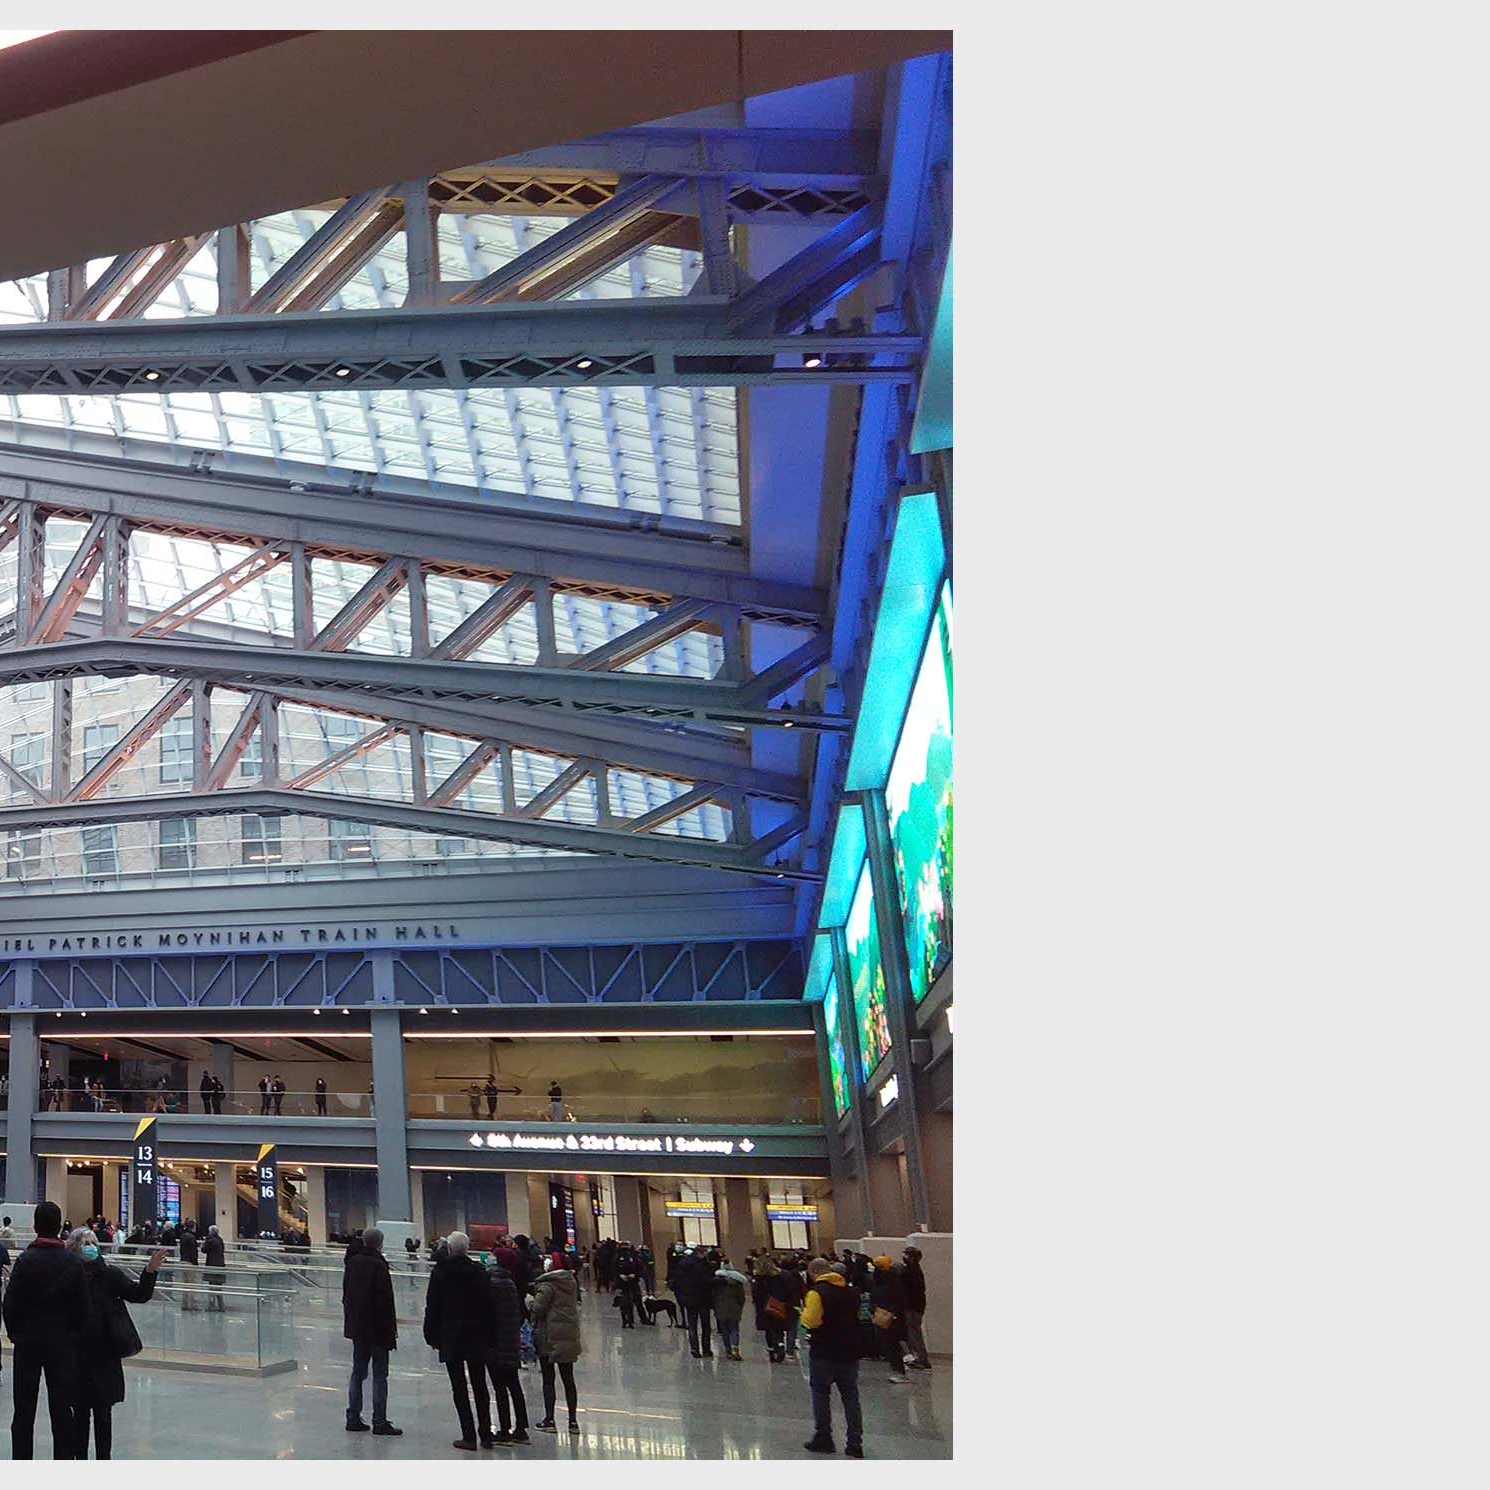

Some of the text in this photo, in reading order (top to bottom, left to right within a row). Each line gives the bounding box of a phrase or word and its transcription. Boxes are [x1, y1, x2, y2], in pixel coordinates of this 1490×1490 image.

[48, 935, 143, 950] PATRICK
[159, 931, 285, 947] MOYNIHAN
[300, 927, 377, 943] TRAIN
[395, 925, 459, 940] HALL
[615, 1135, 662, 1152] Street
[675, 1136, 734, 1155] Subway
[138, 1146, 153, 1160] 13
[137, 1169, 153, 1185] 14
[261, 1167, 274, 1179] 15
[261, 1186, 274, 1198] 16
